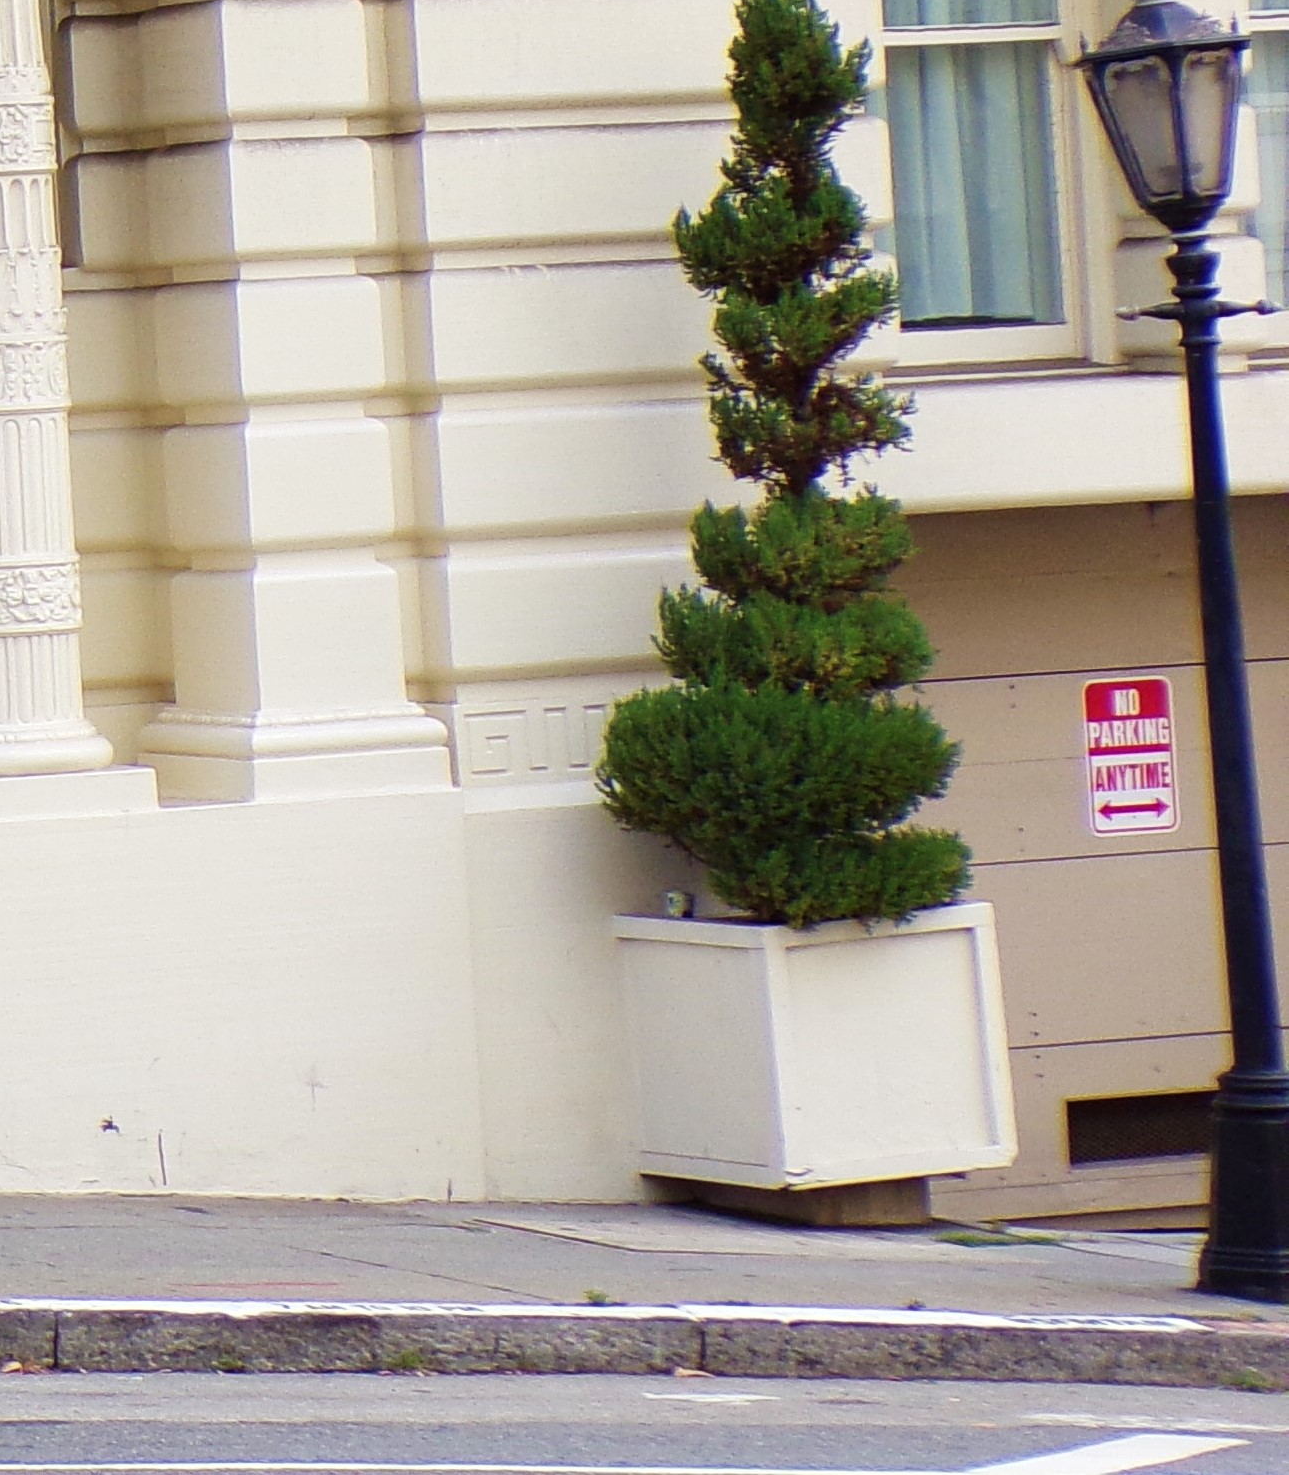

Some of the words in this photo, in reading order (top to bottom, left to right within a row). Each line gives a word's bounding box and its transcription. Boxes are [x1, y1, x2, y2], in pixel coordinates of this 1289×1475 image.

[1113, 688, 1141, 716] NO
[1088, 718, 1170, 747] PARKING
[1096, 761, 1171, 792] ANYTIME
